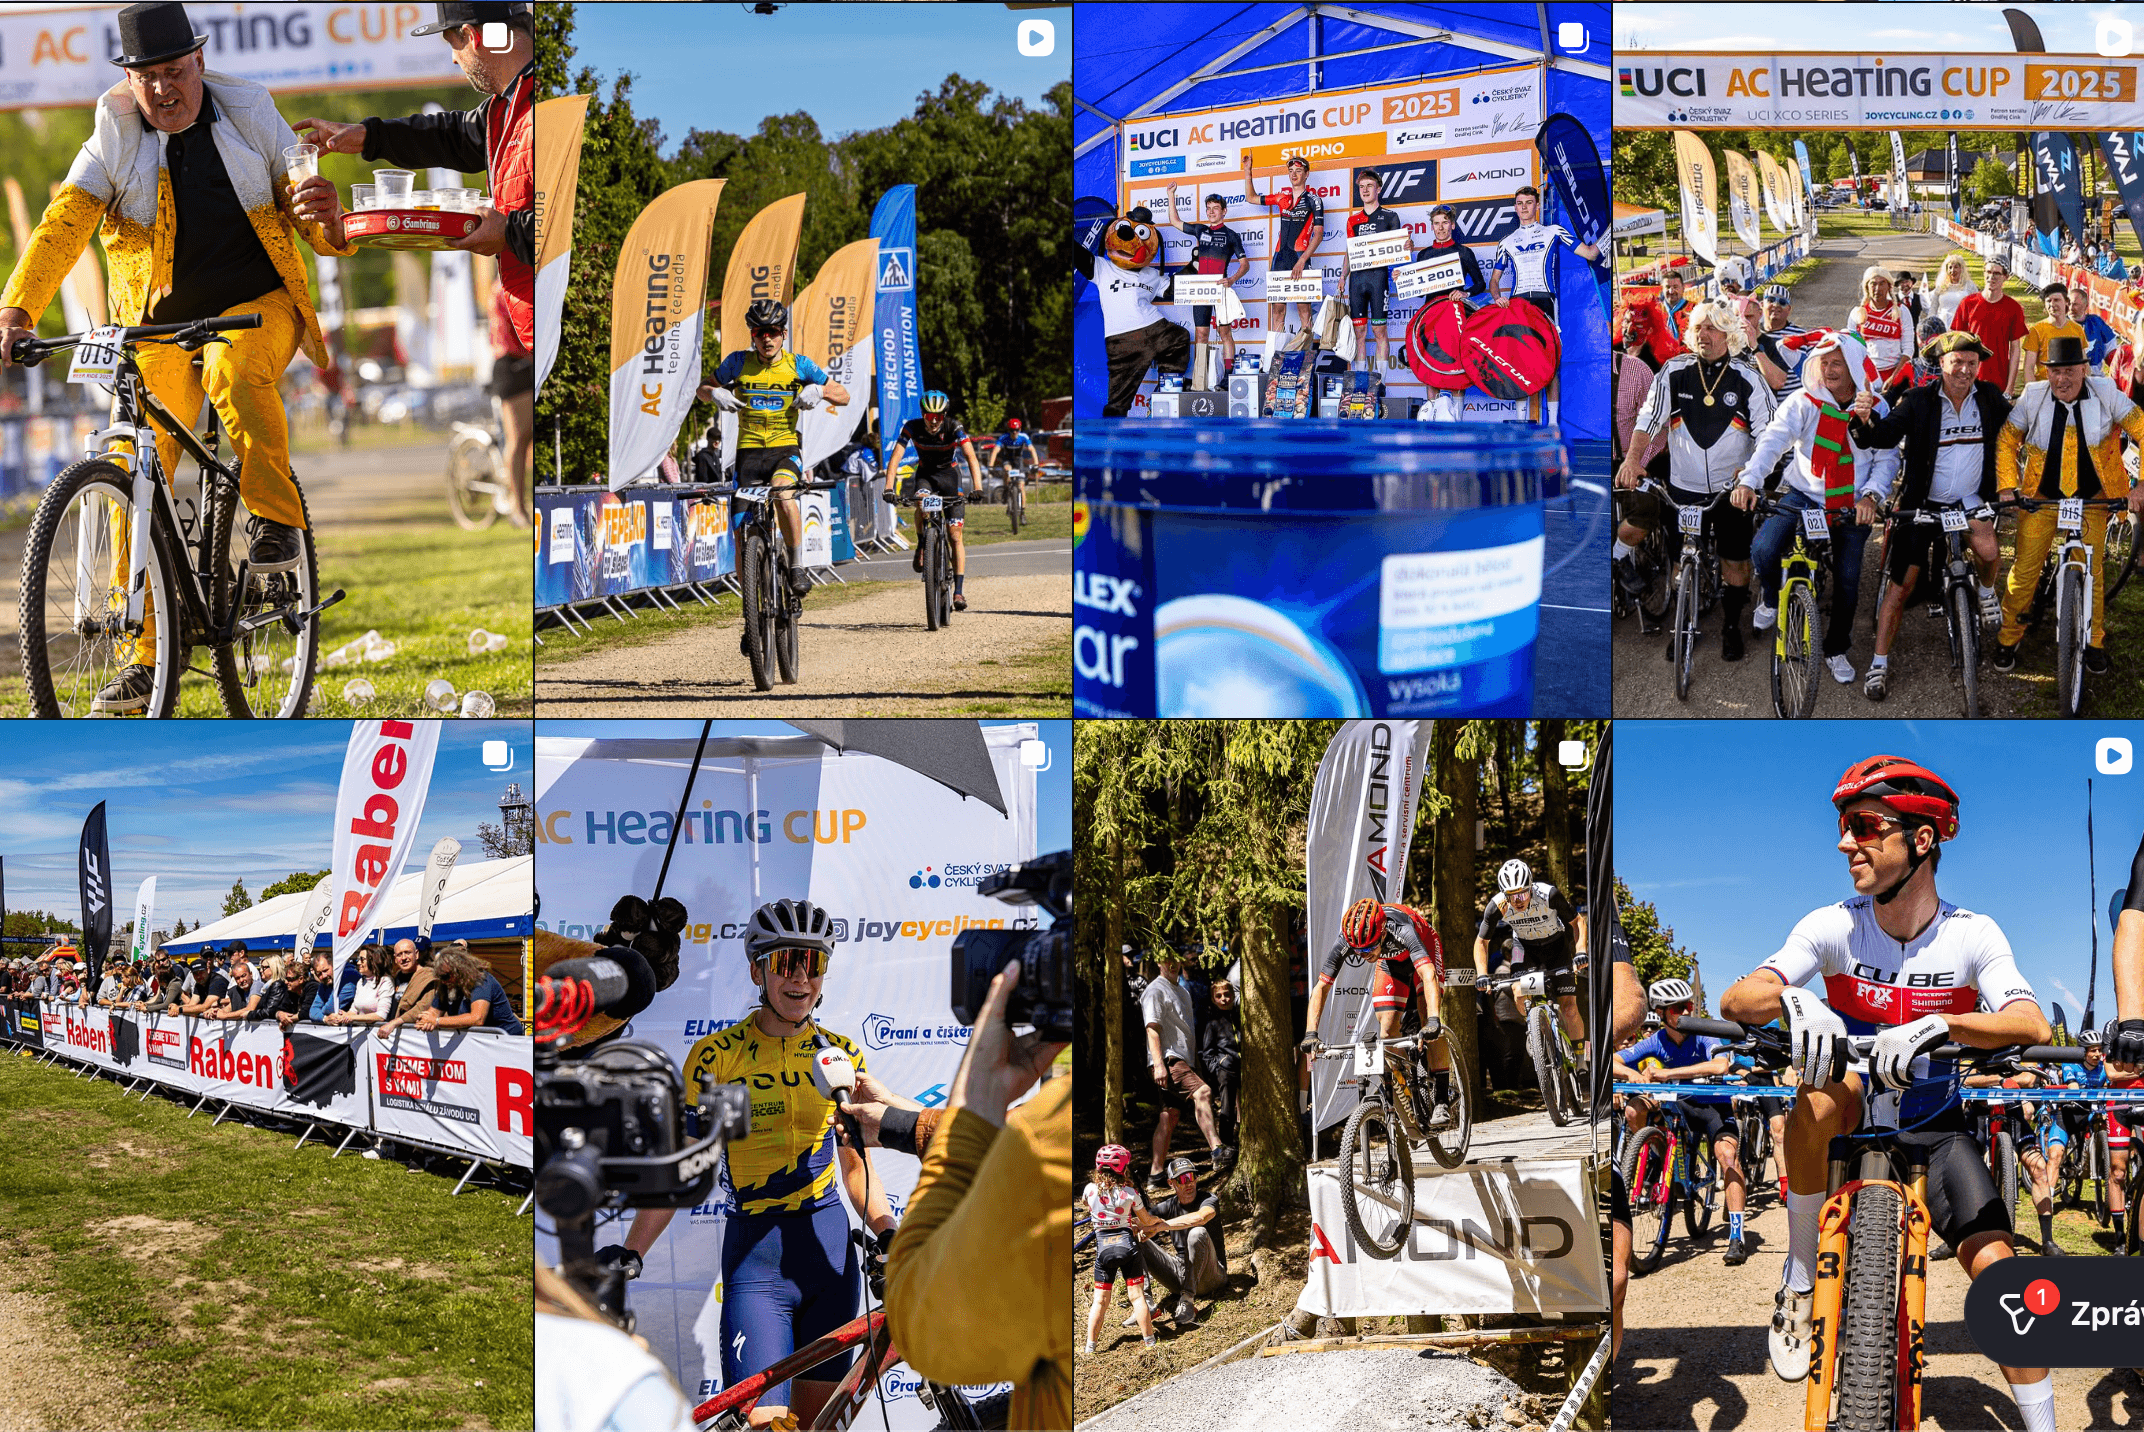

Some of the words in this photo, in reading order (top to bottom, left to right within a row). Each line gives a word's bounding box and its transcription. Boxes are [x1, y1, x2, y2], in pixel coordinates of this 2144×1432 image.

[31, 26, 89, 67] AC
[327, 6, 421, 43] CUP
[1492, 87, 1514, 97] ČESKÝ
[1514, 85, 1532, 94] SVAZ
[1634, 67, 1707, 97] UCI
[1726, 67, 1770, 98] AC
[1941, 66, 2011, 97] CUP
[2041, 69, 2121, 99] 2025
[1491, 93, 1528, 103] CYKLISTIKY
[1688, 106, 1712, 115] ČESKÝ
[1713, 107, 1732, 115] SVAZ
[1689, 114, 1729, 122] CYKLISTIKY
[1747, 109, 1770, 121] UCI
[1773, 110, 1802, 121] XCO
[1804, 110, 1849, 121] SERIES
[1865, 110, 1938, 120] JOYCYCLING.CZ
[1139, 128, 1178, 150] UCI
[1188, 124, 1214, 146] AC
[1322, 103, 1371, 128] CUP
[1390, 92, 1453, 121] 2025
[1406, 131, 1443, 141] CUBE
[1280, 142, 1345, 162] STUPNO
[1139, 159, 1177, 168] JOYCYCLING.CZ
[1467, 167, 1526, 182] AMOND
[1554, 140, 1591, 225] CUBE
[402, 215, 440, 230] Gambrinus
[670, 253, 686, 315] čerpadla
[1427, 268, 1454, 282] 200
[1863, 321, 1898, 336] DADDY
[80, 342, 114, 365] 015
[667, 321, 681, 374] tepelná
[900, 306, 918, 399] TRANSITION
[883, 327, 900, 401] PŘECHOD
[640, 382, 663, 417] AC
[923, 498, 941, 509] 623
[2061, 506, 2080, 521] 015
[1807, 518, 1826, 530] 021
[1404, 755, 1413, 798] centrum
[1367, 722, 1392, 874] AMOND
[782, 808, 867, 845] CUP
[1401, 799, 1410, 839] servisní
[944, 862, 983, 876] ČESKÝ
[1528, 976, 1537, 990] 2
[1856, 982, 1894, 1007] FOX
[1911, 998, 1953, 1007] SHIMANO
[1791, 995, 1804, 1021] CUBE
[66, 1017, 107, 1054] Raben
[880, 1025, 918, 1040] Praní
[922, 1028, 931, 1039] a
[1908, 1023, 1936, 1043] CUBE
[189, 1035, 274, 1090] Raben
[383, 1057, 425, 1076] JEDEME
[427, 1061, 434, 1077] V
[437, 1062, 465, 1081] TOM
[1365, 1051, 1374, 1068] 3
[385, 1077, 392, 1092] S
[393, 1076, 420, 1096] VÁMI
[386, 1097, 415, 1110] LOGISTIKA
[439, 1104, 465, 1120] ZÁVODŮ
[465, 1111, 477, 1122] UCI
[1817, 1251, 1840, 1280] 3
[1905, 1254, 1926, 1283] 4
